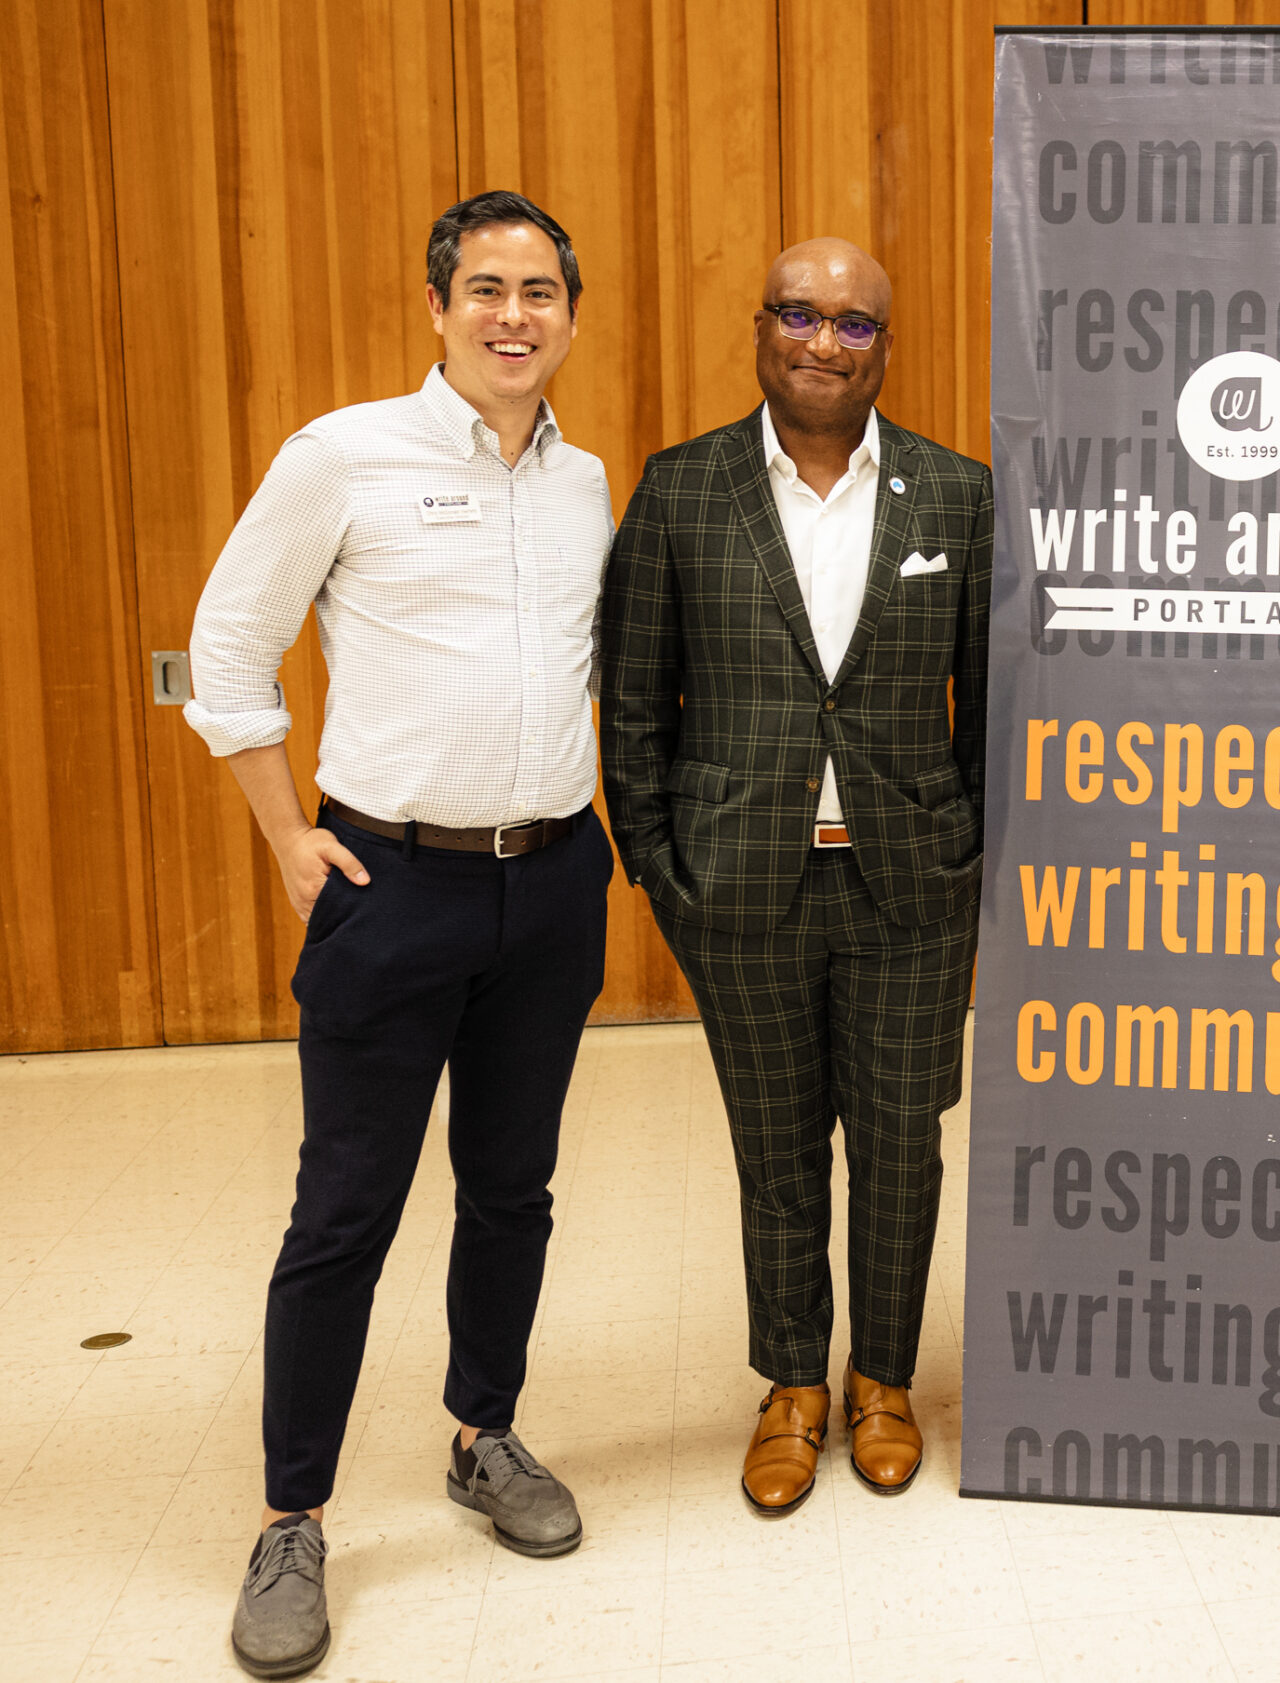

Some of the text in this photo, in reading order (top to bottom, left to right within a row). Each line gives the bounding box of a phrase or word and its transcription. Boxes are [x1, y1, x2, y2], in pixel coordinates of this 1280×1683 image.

[1207, 445, 1278, 458] Est. 1999
[1029, 489, 1197, 575] write
